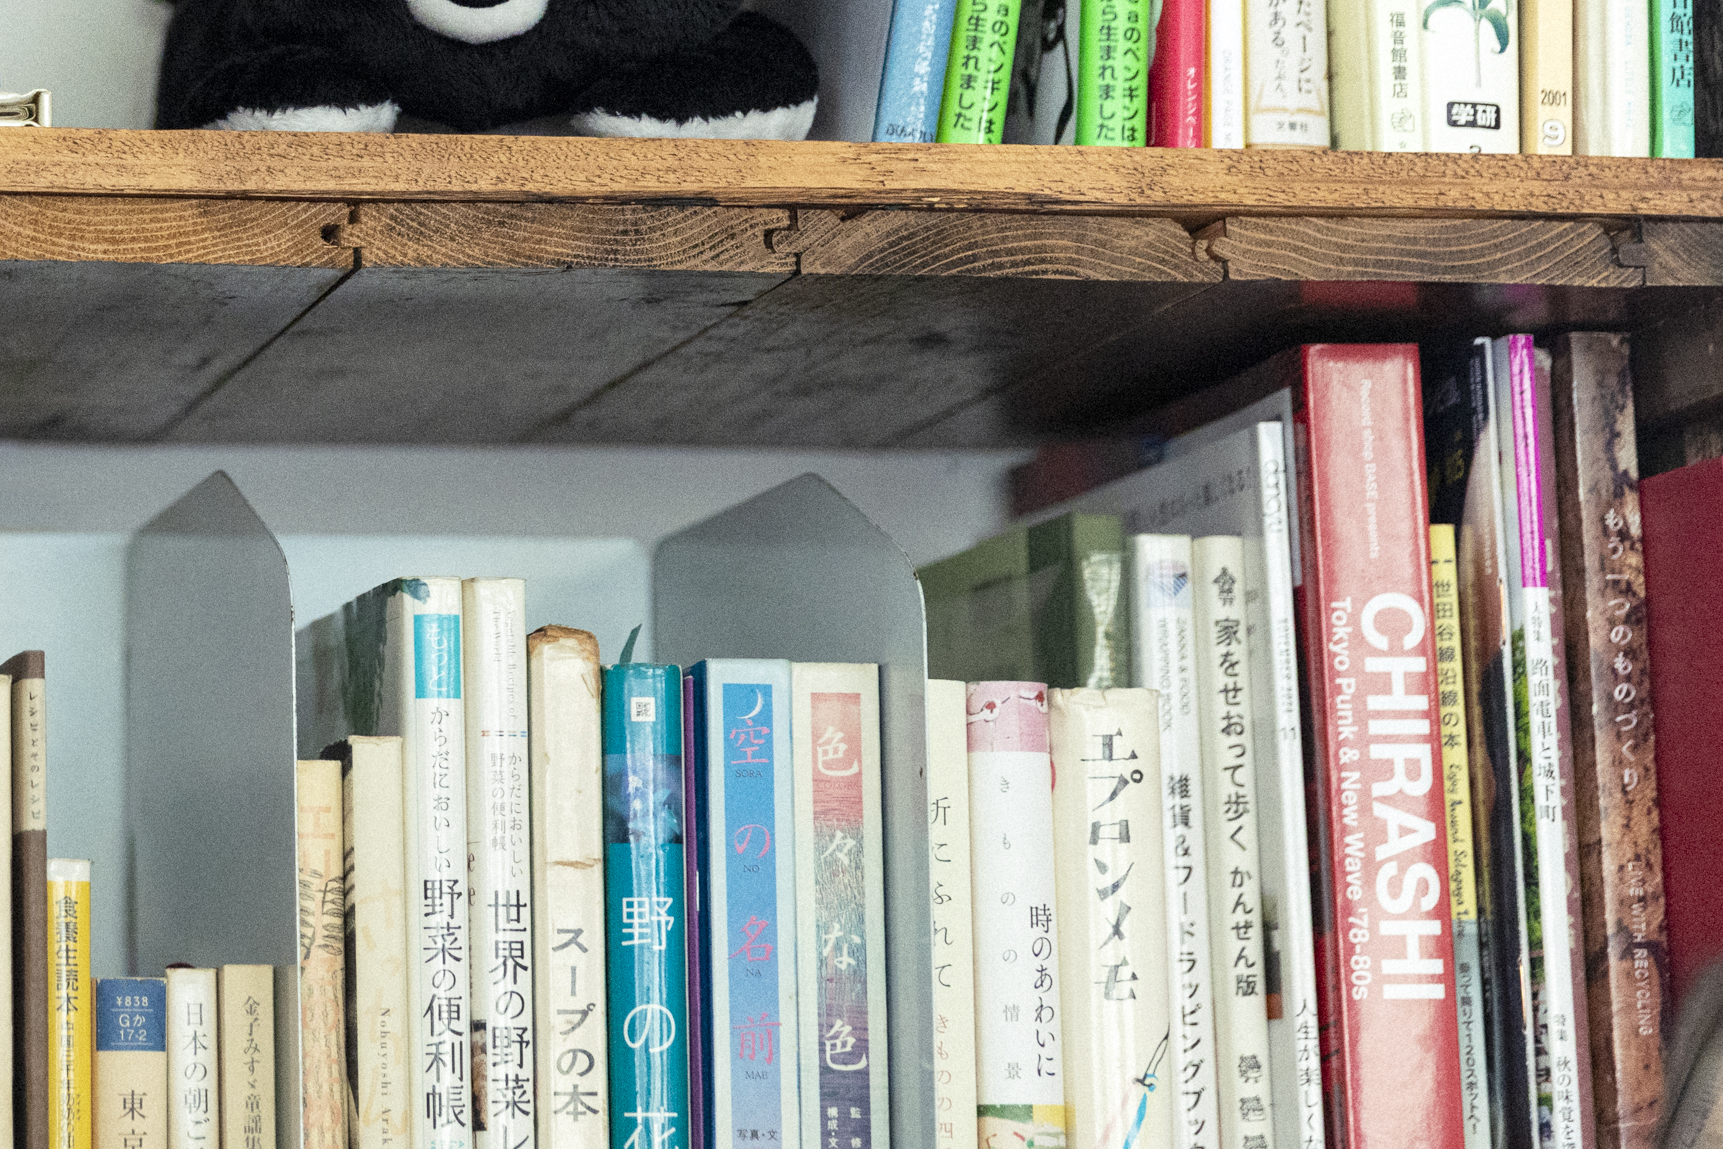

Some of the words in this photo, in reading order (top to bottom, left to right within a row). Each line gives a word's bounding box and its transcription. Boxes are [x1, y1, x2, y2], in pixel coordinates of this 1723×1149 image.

[1389, 11, 1409, 100] 福音館書店
[1540, 89, 1568, 107] 2001
[1450, 103, 1498, 130] 学研
[1542, 119, 1567, 148] 9
[427, 621, 448, 691] もっと
[1329, 596, 1352, 671] Tokyo
[1604, 507, 1639, 791] もう一つのものづくり
[1214, 616, 1251, 853] 家をせおって歩く
[1334, 677, 1357, 742] Punk
[1530, 657, 1558, 824] 路面電車と城下町
[429, 705, 452, 874] からだにおいしい
[734, 769, 764, 780] SORA
[1339, 746, 1360, 764] &
[1340, 771, 1362, 827] New
[1360, 592, 1446, 1000] CHIRASHI
[490, 752, 508, 852] 野菜の便利帳
[508, 752, 524, 878] からだにおいしい
[728, 718, 782, 1065] 空の名前
[742, 863, 761, 875] NO
[816, 725, 869, 1071] 色々な色
[1080, 726, 1144, 1003] エプロンメモ
[1344, 831, 1365, 901] Wave
[998, 774, 1023, 1083] きものの情景
[1168, 773, 1208, 1149] 雑貨&フードラッピングブッ
[1630, 902, 1646, 945] WITH
[116, 995, 149, 1008] ¥838
[422, 878, 467, 1130] 野菜の便利帳
[745, 967, 763, 978] NA
[1028, 902, 1056, 1078] 時のあわいに
[1633, 948, 1653, 1037] RECYCLING
[379, 1006, 393, 1097] Nobuyoshi
[487, 889, 531, 1149] 世界の野菜レ
[551, 927, 600, 1123] スープの本
[620, 896, 679, 1149] 野の花
[118, 1089, 149, 1149] 東京
[182, 1002, 211, 1149] 日本の朝ご
[744, 1069, 769, 1081] MAE
[934, 1013, 955, 1149] きものの四
[1556, 1055, 1578, 1149] 秋の味覚を
[736, 1128, 779, 1142] 写真・文
[826, 1106, 839, 1149] 構成・文
[849, 1106, 863, 1149] 監修
